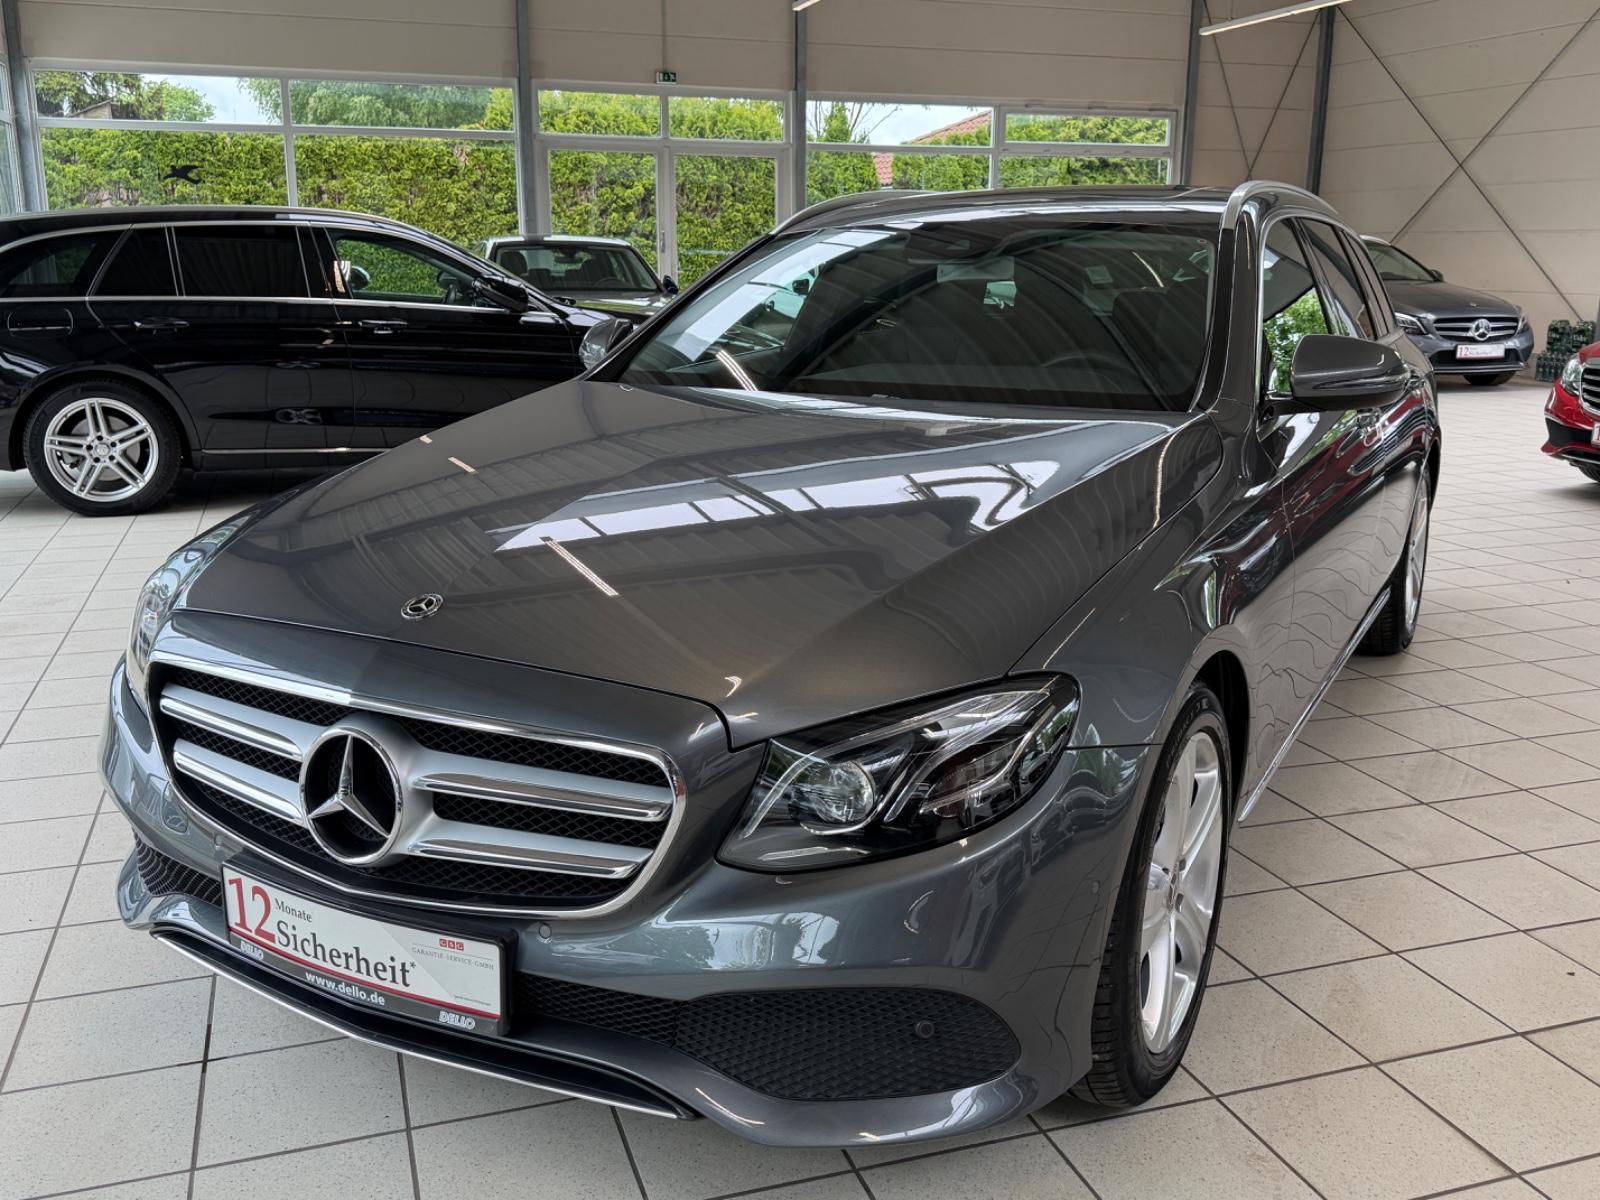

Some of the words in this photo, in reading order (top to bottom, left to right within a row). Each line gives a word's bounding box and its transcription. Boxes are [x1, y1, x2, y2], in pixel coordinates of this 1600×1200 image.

[228, 877, 276, 944] 12
[275, 897, 312, 922] Monate
[305, 972, 385, 1005] www.dello.de
[438, 1010, 476, 1030] DELLO
